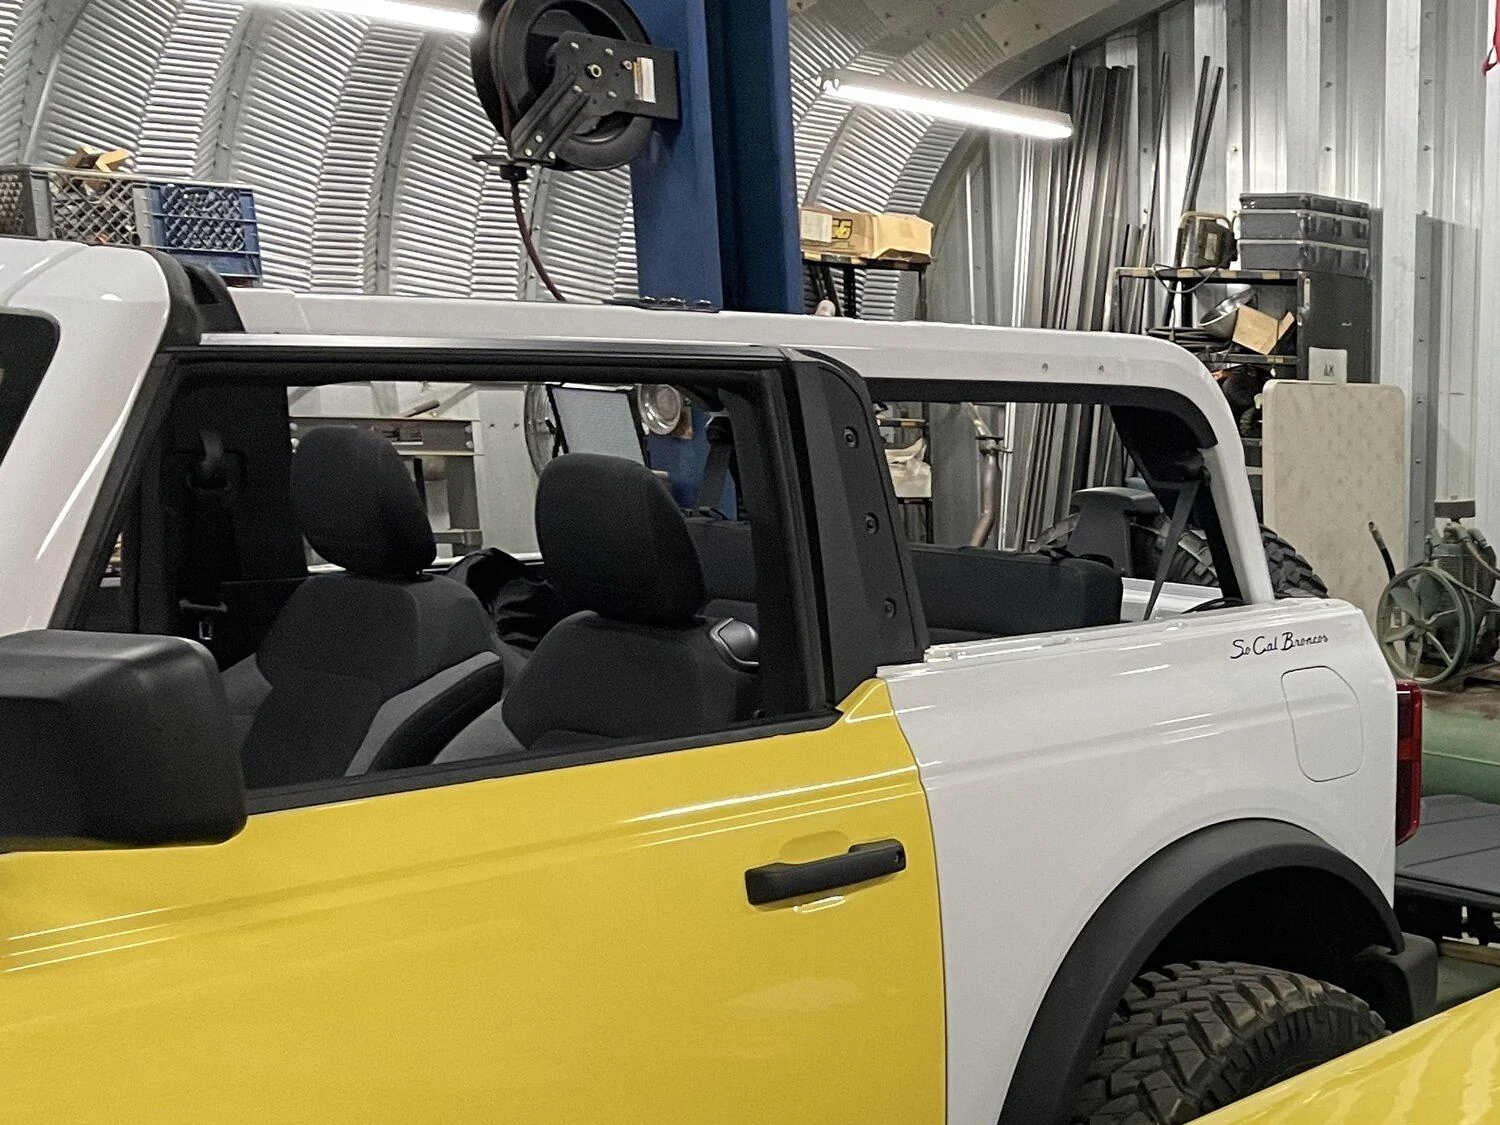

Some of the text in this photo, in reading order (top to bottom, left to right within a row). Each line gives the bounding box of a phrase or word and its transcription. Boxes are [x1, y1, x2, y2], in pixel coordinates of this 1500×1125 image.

[1230, 631, 1329, 659] So Cal Broncos
